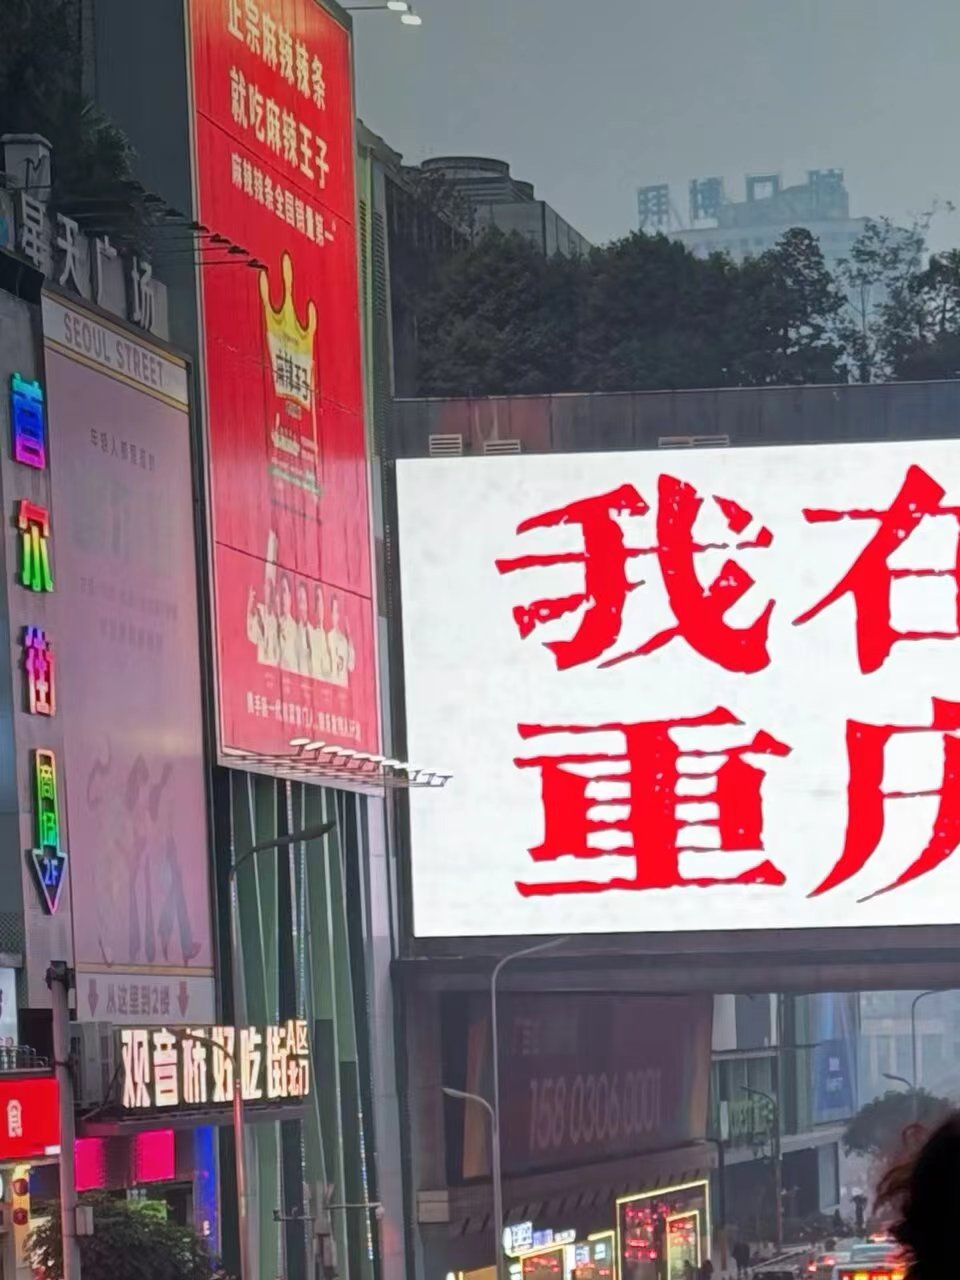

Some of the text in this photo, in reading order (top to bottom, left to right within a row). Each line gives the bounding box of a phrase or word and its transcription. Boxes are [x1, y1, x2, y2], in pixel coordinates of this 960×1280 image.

[229, 66, 330, 189] 就吃麻辣王子
[63, 312, 164, 387] SEOUL STREET
[43, 859, 58, 885] 2F
[121, 1025, 287, 1109] 观音桥好吃街
